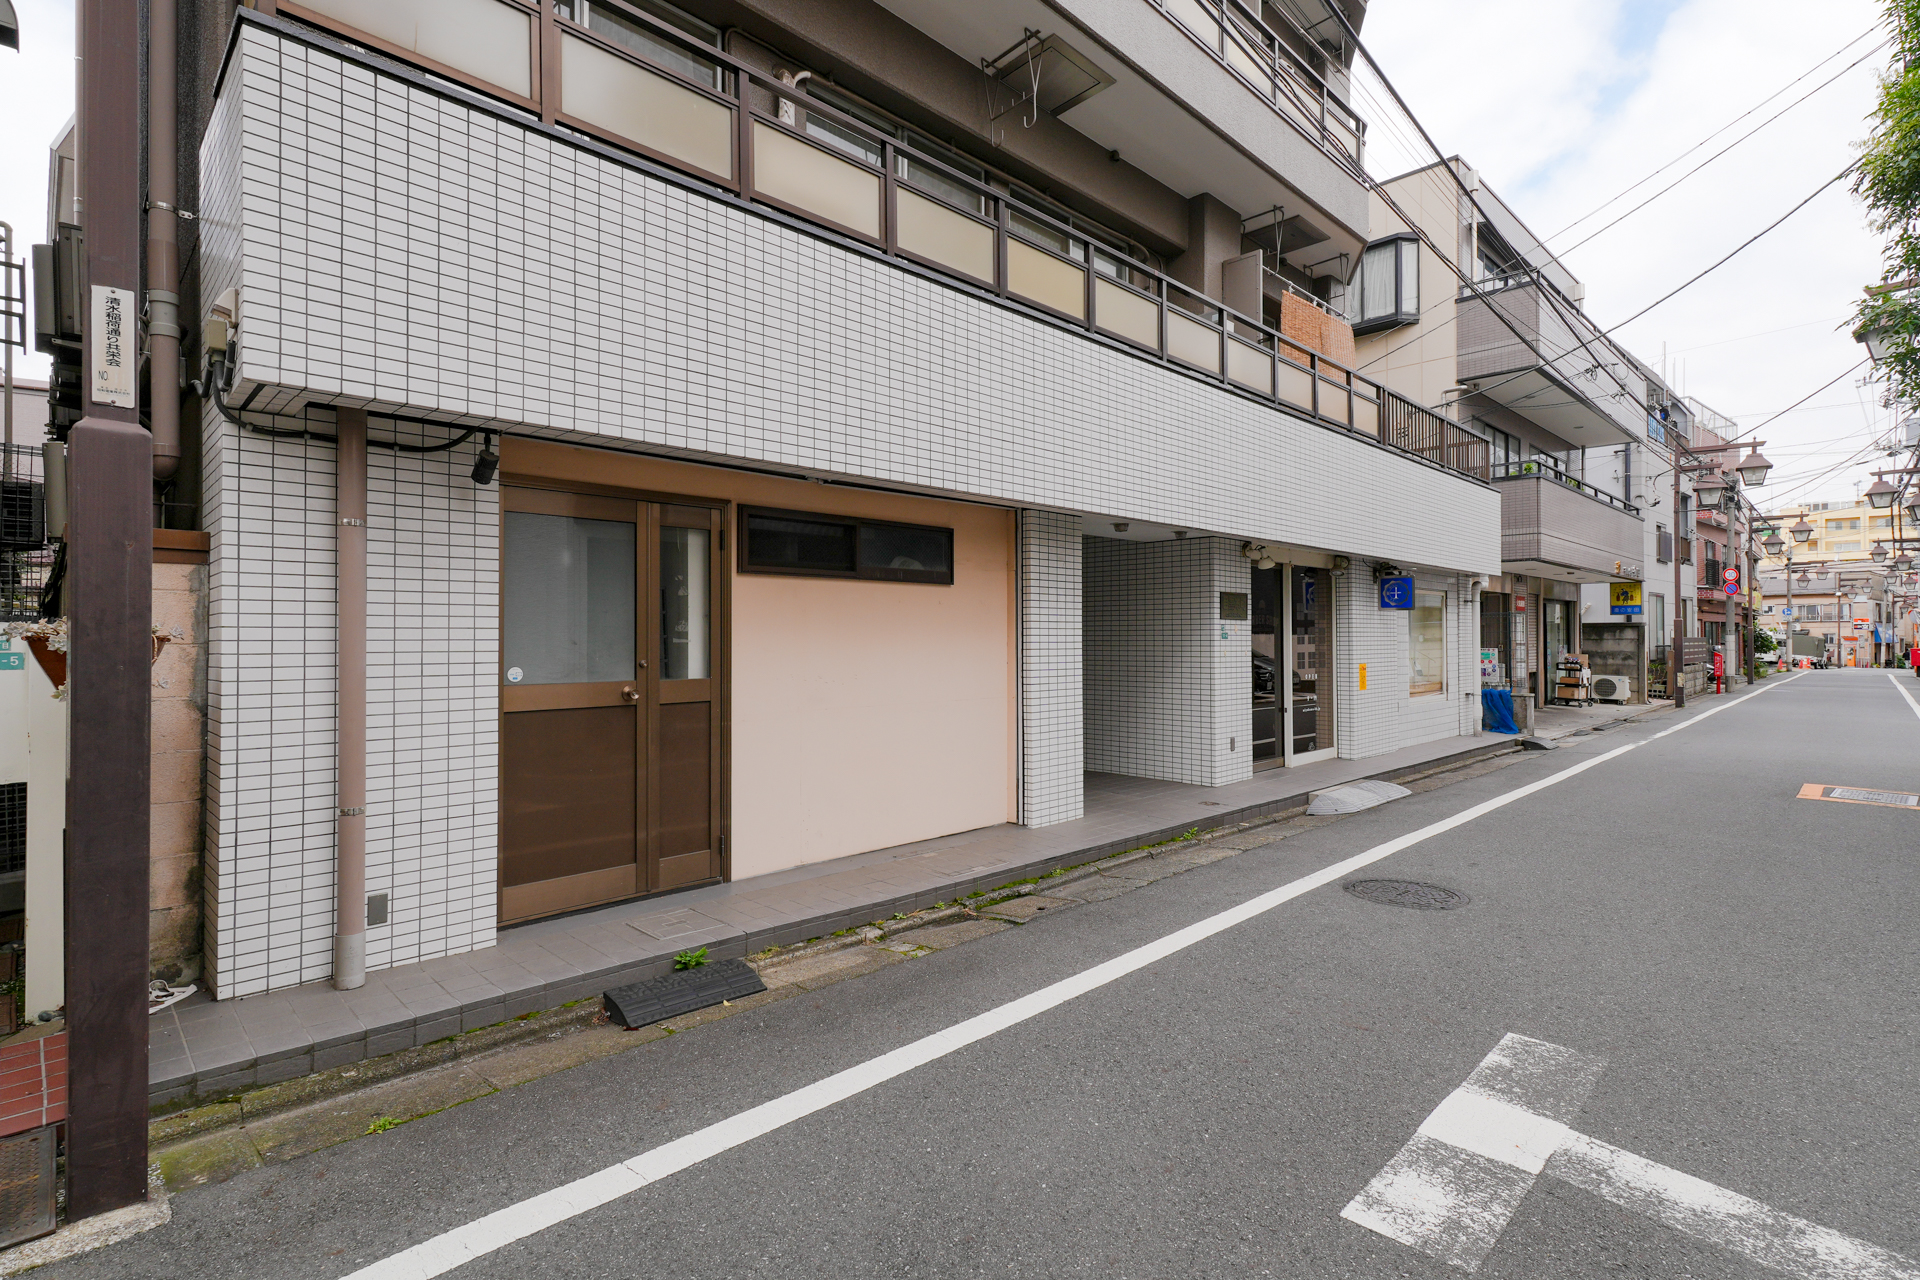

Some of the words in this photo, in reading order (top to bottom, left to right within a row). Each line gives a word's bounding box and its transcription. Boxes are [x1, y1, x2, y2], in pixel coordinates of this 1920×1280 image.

[105, 296, 121, 367] 清水稲荷通り共栄会
